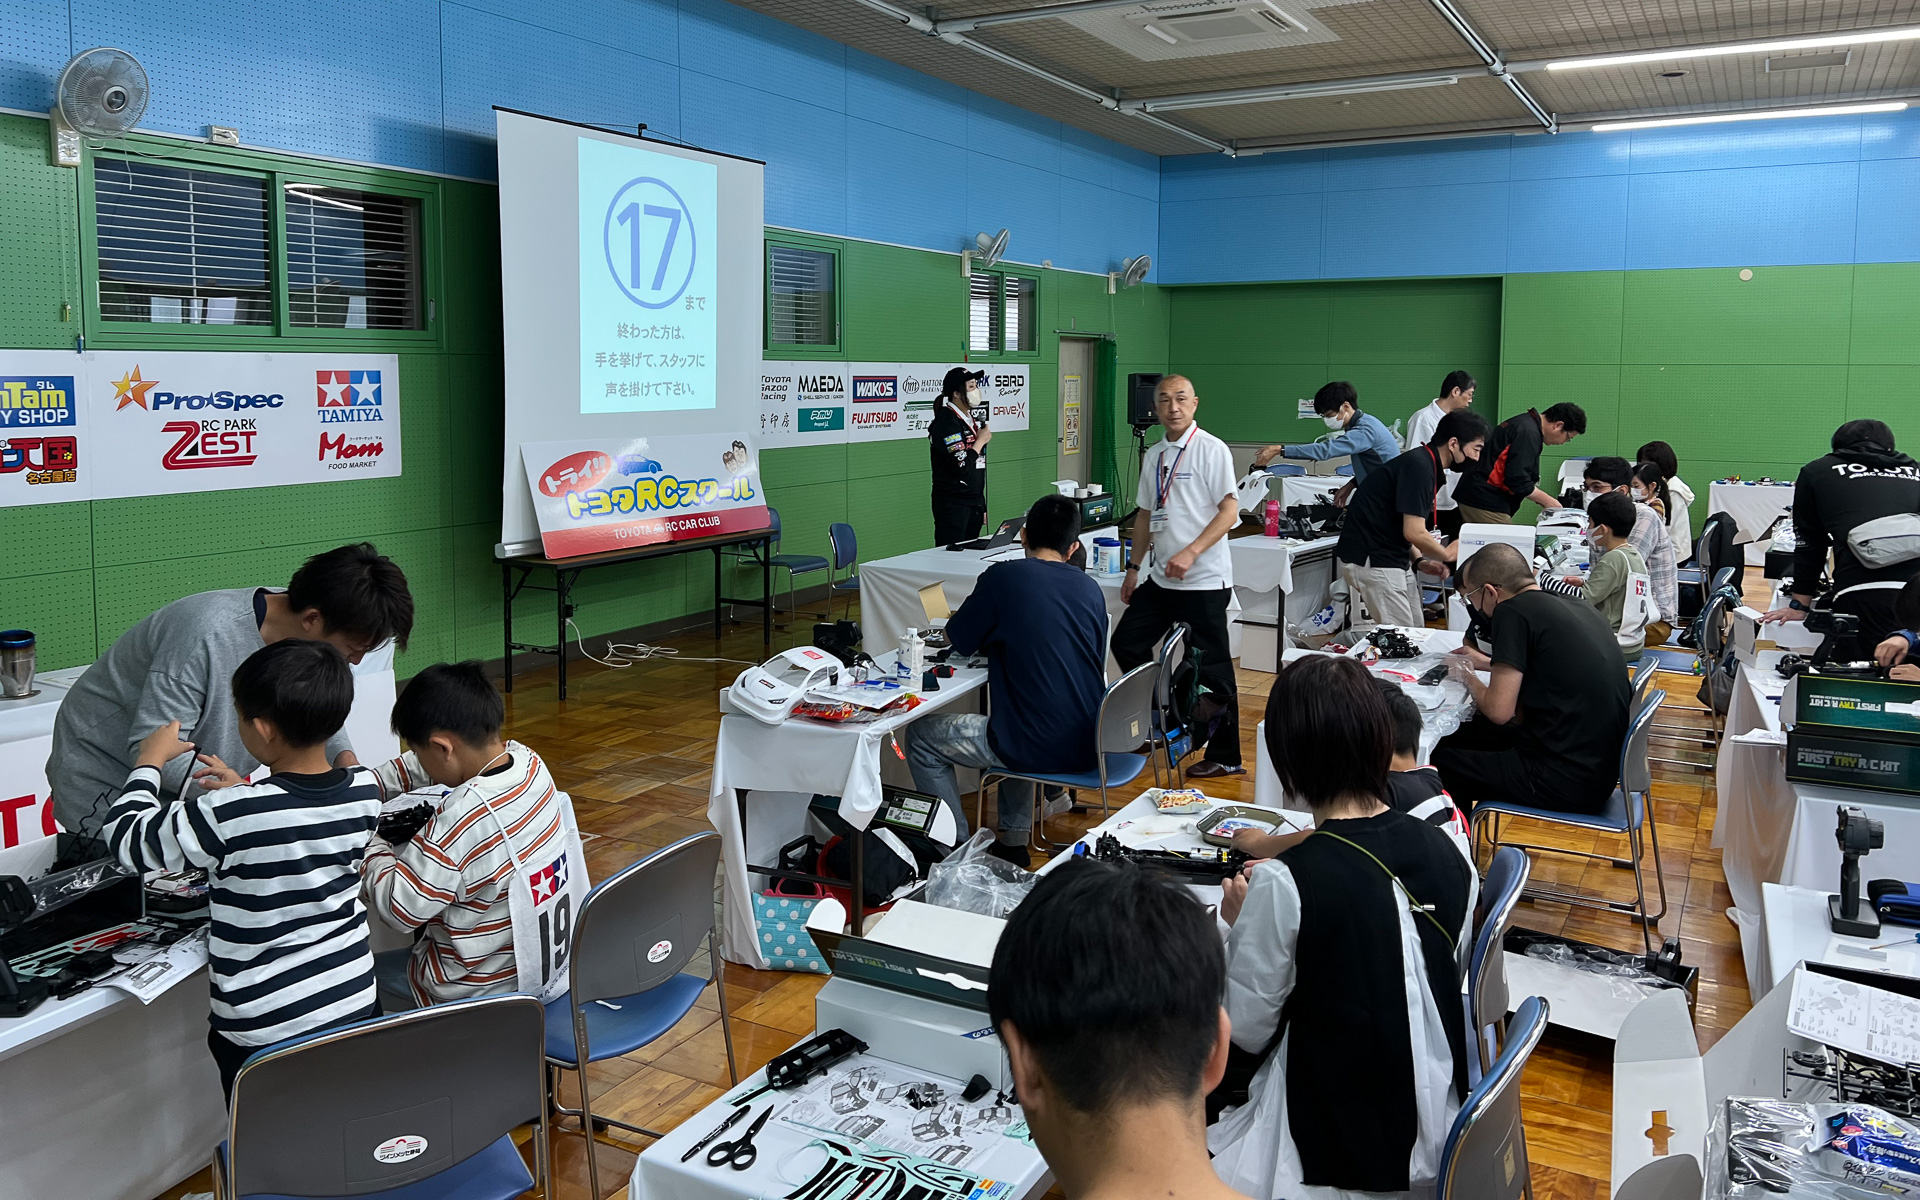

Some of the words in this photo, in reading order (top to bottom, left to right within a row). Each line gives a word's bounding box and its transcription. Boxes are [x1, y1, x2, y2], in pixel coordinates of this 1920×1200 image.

[685, 295, 706, 311] まで
[617, 322, 685, 340] 終わった方は、
[595, 351, 706, 368] 手を挙げて、スタッフに
[36, 381, 55, 390] タム
[605, 381, 695, 397] 声を掛けて下さい。
[798, 375, 844, 392] MAEDA
[998, 388, 1021, 397] Racing
[18, 409, 69, 424] SHOP
[318, 408, 384, 423] TAMIYA
[851, 411, 898, 424] FUJITSUBO
[201, 419, 221, 431] RC
[224, 419, 257, 431] PARK
[161, 421, 258, 470] ZEST
[319, 431, 384, 461] Mom
[349, 460, 377, 468] MARKET
[26, 471, 76, 485] 名古屋店
[565, 475, 755, 519] トヨタRCスクール
[613, 525, 652, 539] TOYOTA
[664, 520, 679, 532] RC
[678, 518, 698, 531] CAR
[698, 516, 721, 527] CLUB
[1809, 698, 1823, 707] KIT
[1838, 701, 1855, 709] TRY
[1856, 703, 1881, 712] FIRST
[1797, 752, 1832, 765] FIRST
[1834, 755, 1857, 767] TRY
[1880, 760, 1901, 772] KIT
[538, 892, 571, 987] 19
[864, 958, 883, 968] TRY
[884, 962, 914, 975] FIRST
